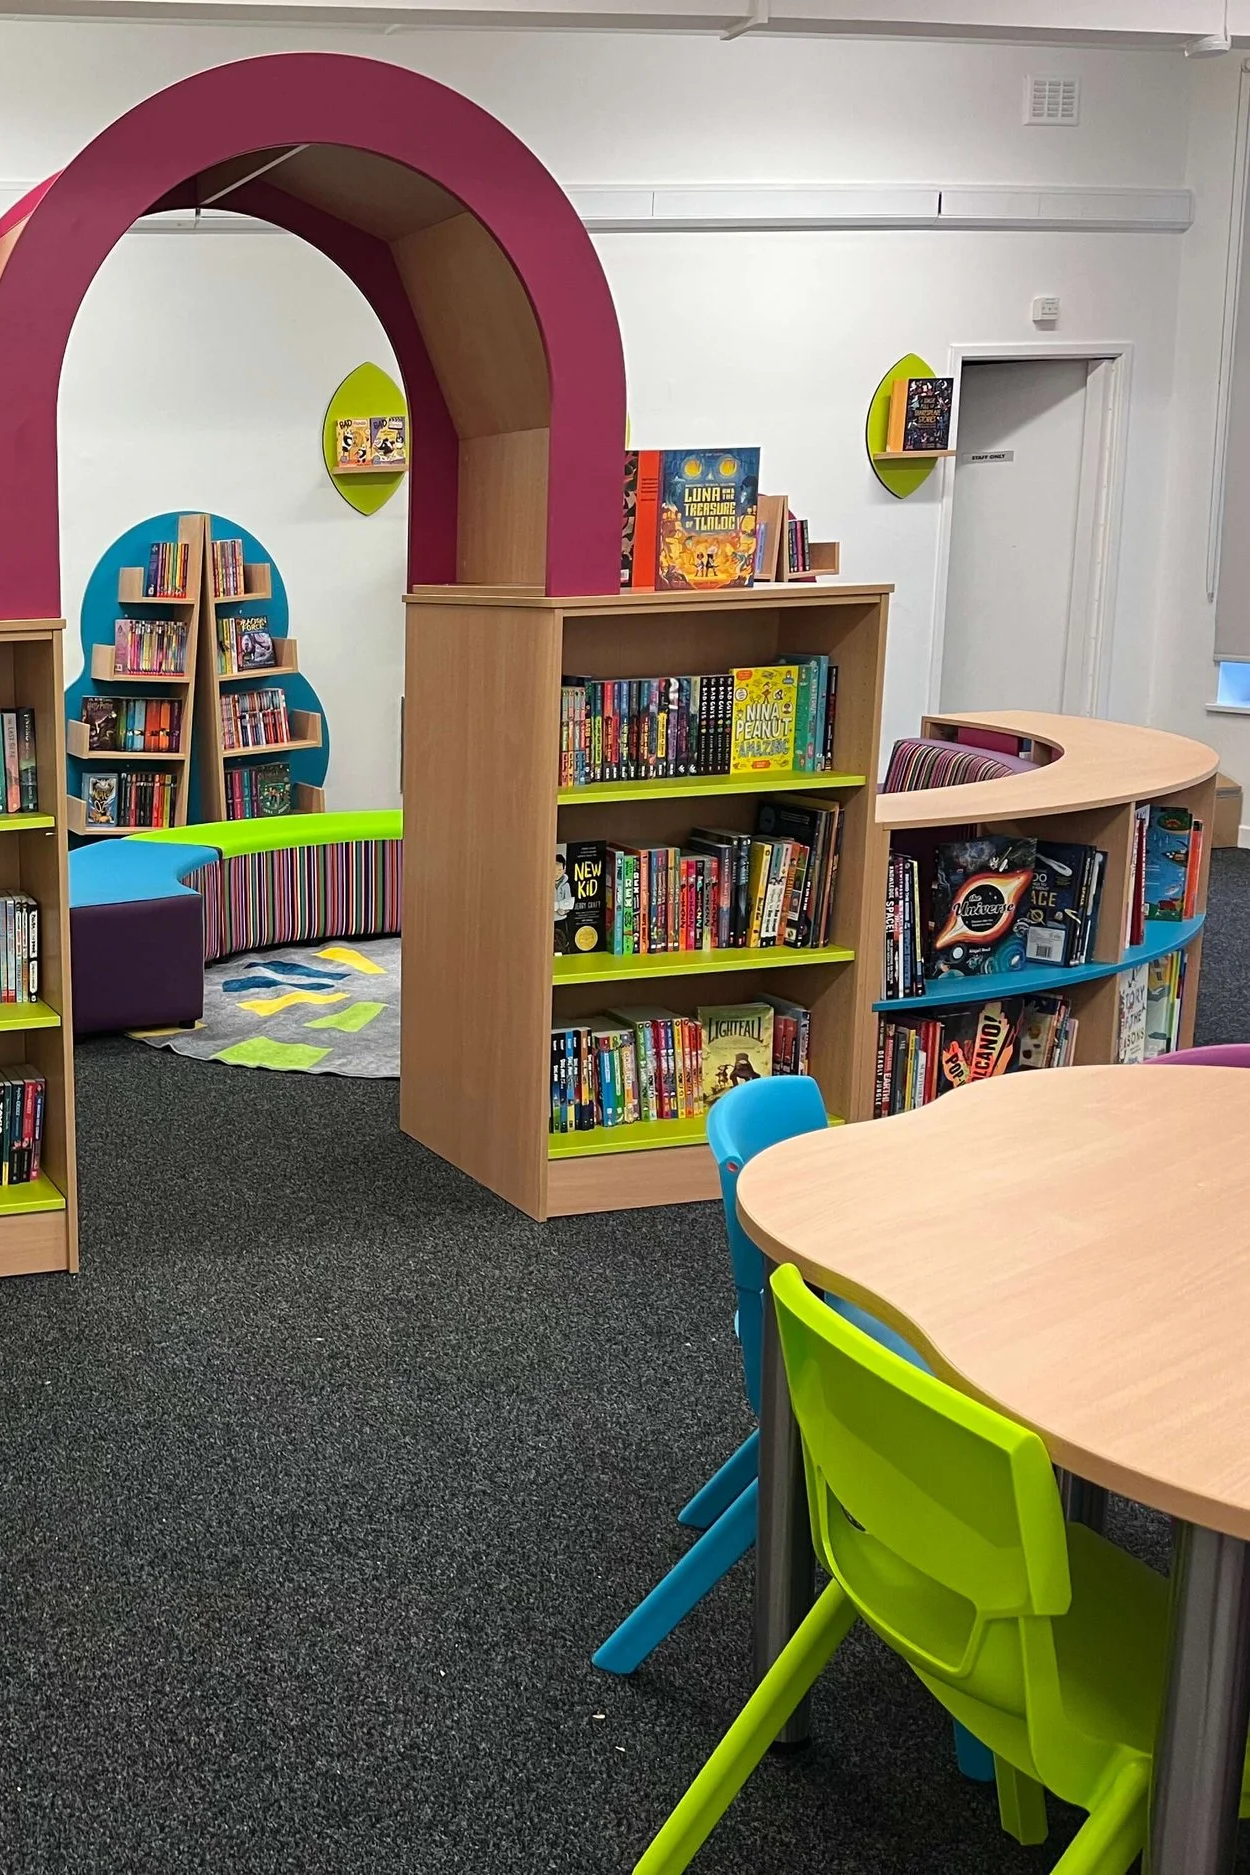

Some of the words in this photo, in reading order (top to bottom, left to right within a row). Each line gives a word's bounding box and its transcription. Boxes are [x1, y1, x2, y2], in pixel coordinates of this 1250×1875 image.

[339, 420, 352, 430] BAD
[684, 487, 720, 502] LUNA
[684, 502, 736, 516] TREASURE
[694, 516, 736, 530] TLALOC
[746, 702, 780, 720] NINA
[736, 718, 792, 740] PEANUT
[574, 860, 602, 882] NEW
[625, 878, 633, 907] REX
[969, 894, 982, 902] the
[885, 901, 894, 933] SPACE!
[952, 901, 1015, 917] Universe
[707, 1015, 765, 1044] LIGHTFALL
